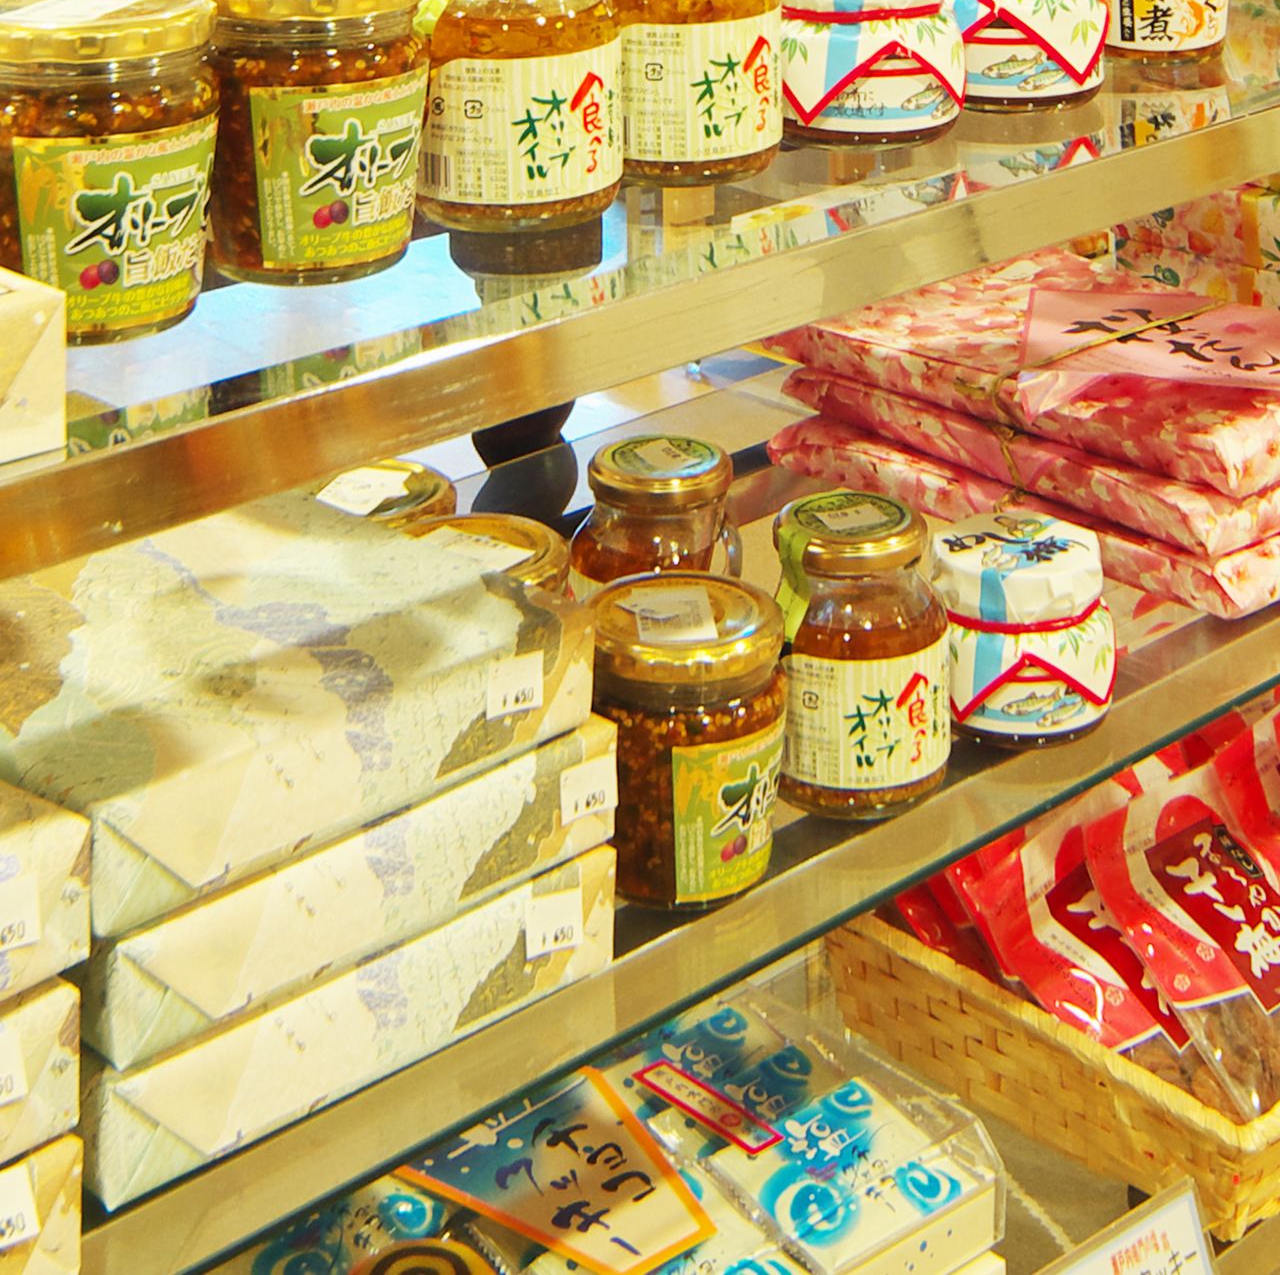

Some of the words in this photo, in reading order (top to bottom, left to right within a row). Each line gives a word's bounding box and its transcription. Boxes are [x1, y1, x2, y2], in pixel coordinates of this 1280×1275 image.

[689, 70, 723, 139] オイル
[709, 52, 747, 127] オリーブ
[742, 34, 772, 132] 食べる
[510, 109, 548, 181] オイル
[531, 89, 577, 169] オリーブ
[570, 70, 605, 174] 食べる
[842, 706, 875, 769] オイル
[860, 688, 902, 760] オリーブ
[897, 672, 929, 763] 食べる
[495, 1156, 643, 1258] クッキー
